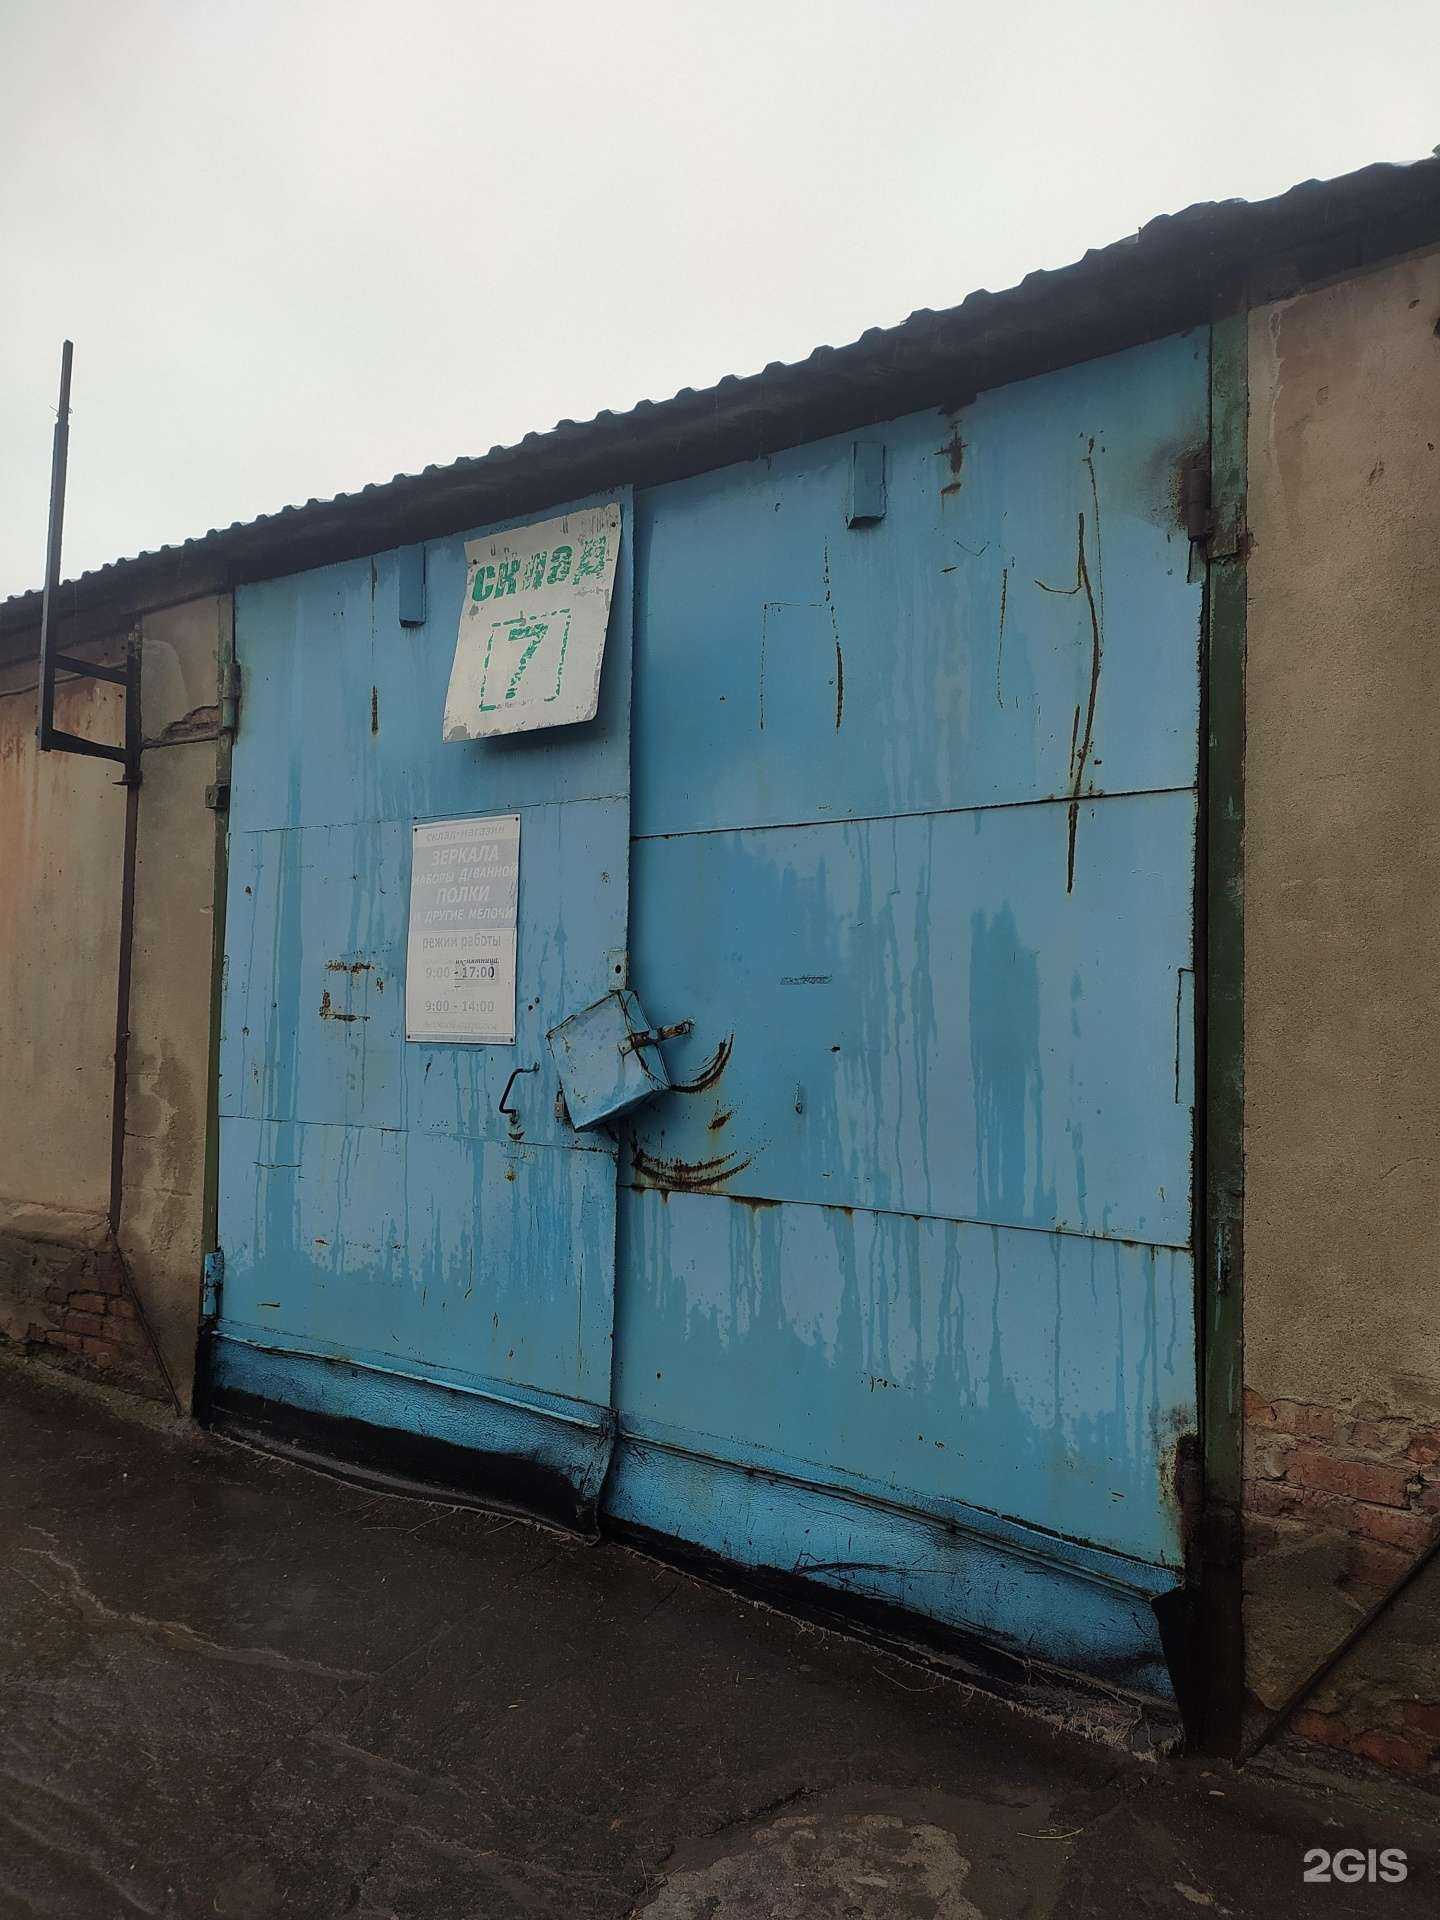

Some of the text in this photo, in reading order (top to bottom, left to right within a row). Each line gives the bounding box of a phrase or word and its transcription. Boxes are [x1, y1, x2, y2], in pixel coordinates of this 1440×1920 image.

[505, 623, 550, 700] 7
[431, 844, 499, 865] ЗЕРКАЛА
[436, 885, 491, 905] ПОЛКИ
[424, 909, 464, 924] ДРУГИЕ
[469, 906, 515, 921] МЕЛОЧИ
[462, 966, 495, 979] 17:00
[424, 1000, 449, 1012] 9:00
[462, 1000, 495, 1012] 14:00
